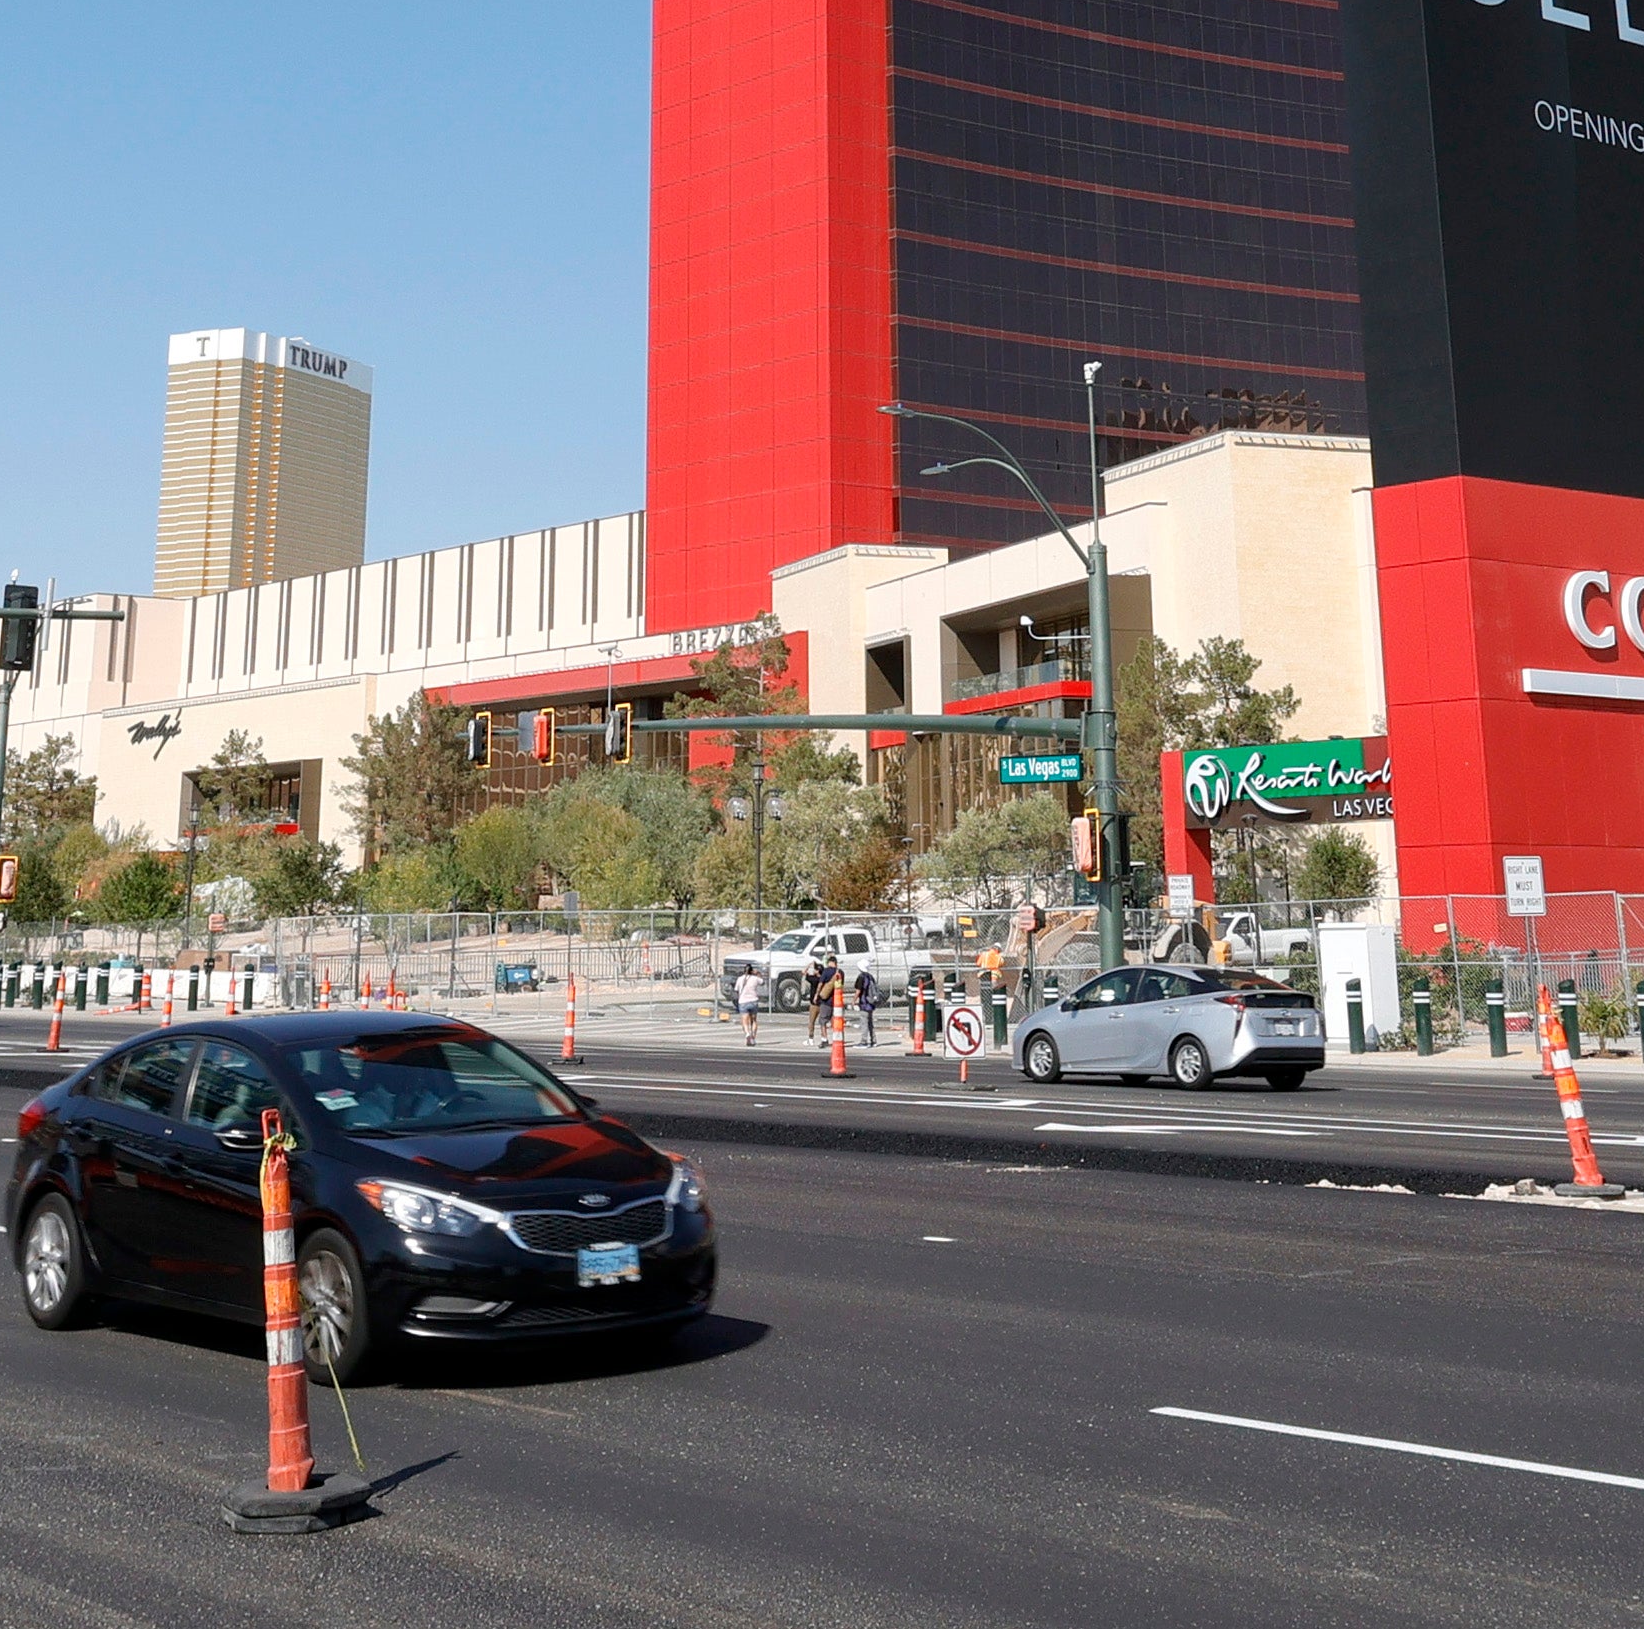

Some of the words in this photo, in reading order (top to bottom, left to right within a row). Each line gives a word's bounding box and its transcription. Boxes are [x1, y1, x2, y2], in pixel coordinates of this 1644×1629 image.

[196, 336, 211, 357] T
[289, 344, 348, 379] TRUMP
[1008, 758, 1027, 777] Las
[1028, 757, 1061, 781] Vegas
[1060, 757, 1077, 767] BLVD
[1236, 752, 1323, 815] Resorts
[1333, 799, 1361, 818] LAS
[1507, 865, 1523, 874] RIGHT
[1524, 865, 1539, 874] LANE
[1515, 880, 1533, 891] MUST
[1510, 897, 1524, 906] TURN
[1526, 897, 1542, 906] RIGHT
